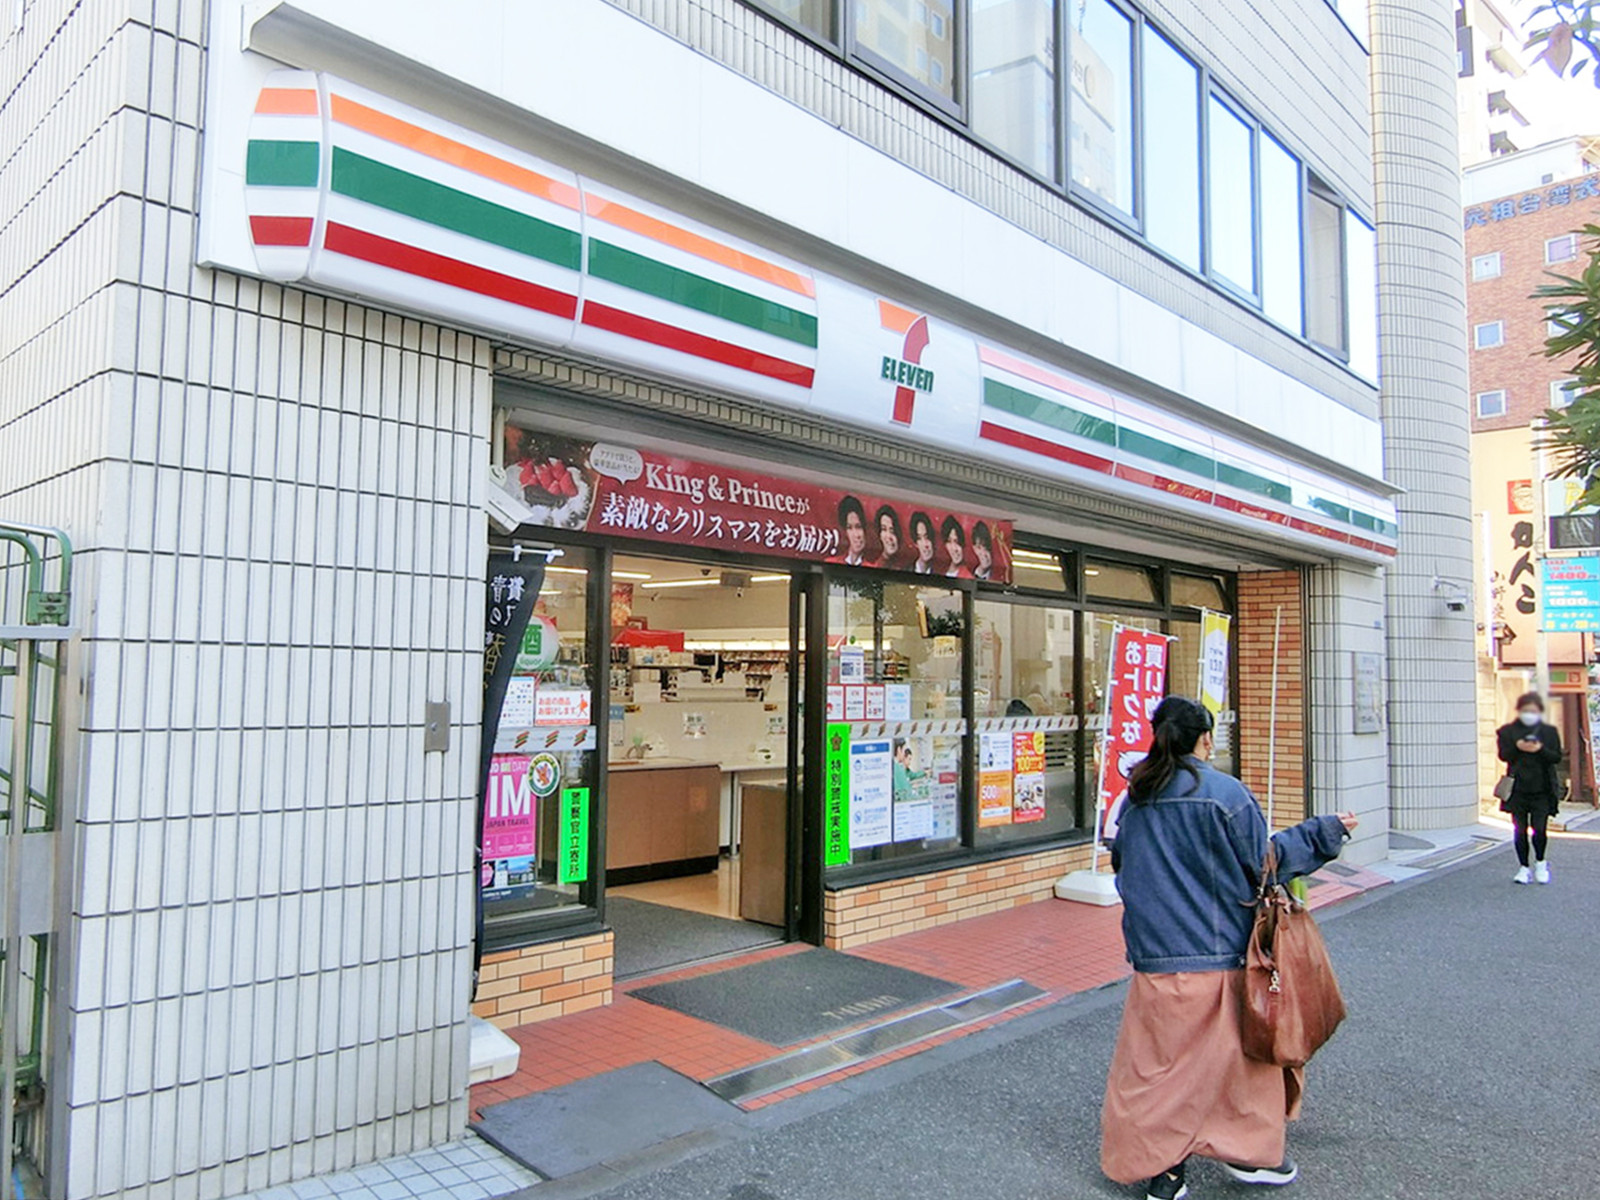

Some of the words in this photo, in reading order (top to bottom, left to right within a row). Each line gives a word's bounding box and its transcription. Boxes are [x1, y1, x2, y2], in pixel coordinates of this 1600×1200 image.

[600, 491, 840, 556] 素敵なクリスマスをお届け!
